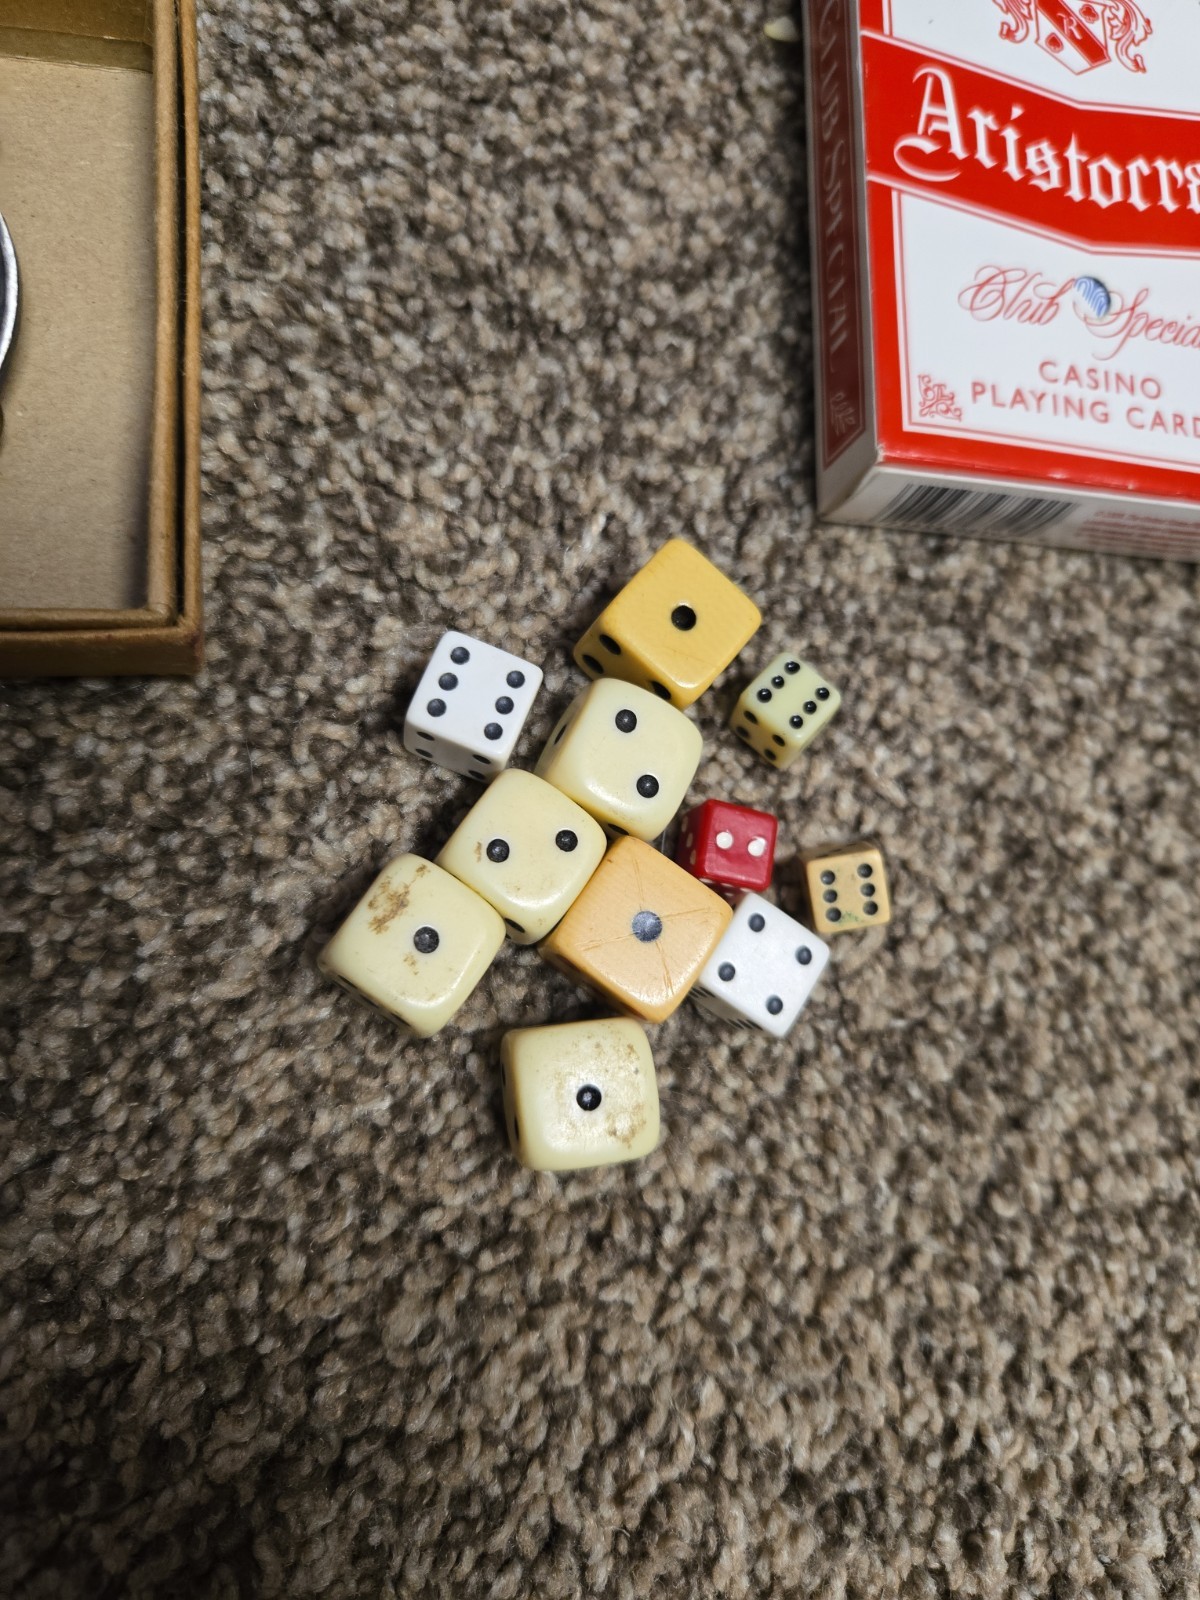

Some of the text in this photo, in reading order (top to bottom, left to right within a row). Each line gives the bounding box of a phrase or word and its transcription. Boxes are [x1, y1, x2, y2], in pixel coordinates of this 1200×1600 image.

[1057, 12, 1083, 40] R
[957, 264, 1077, 326] Club
[1038, 360, 1162, 400] CASINO
[971, 381, 1110, 424] PLAYING
